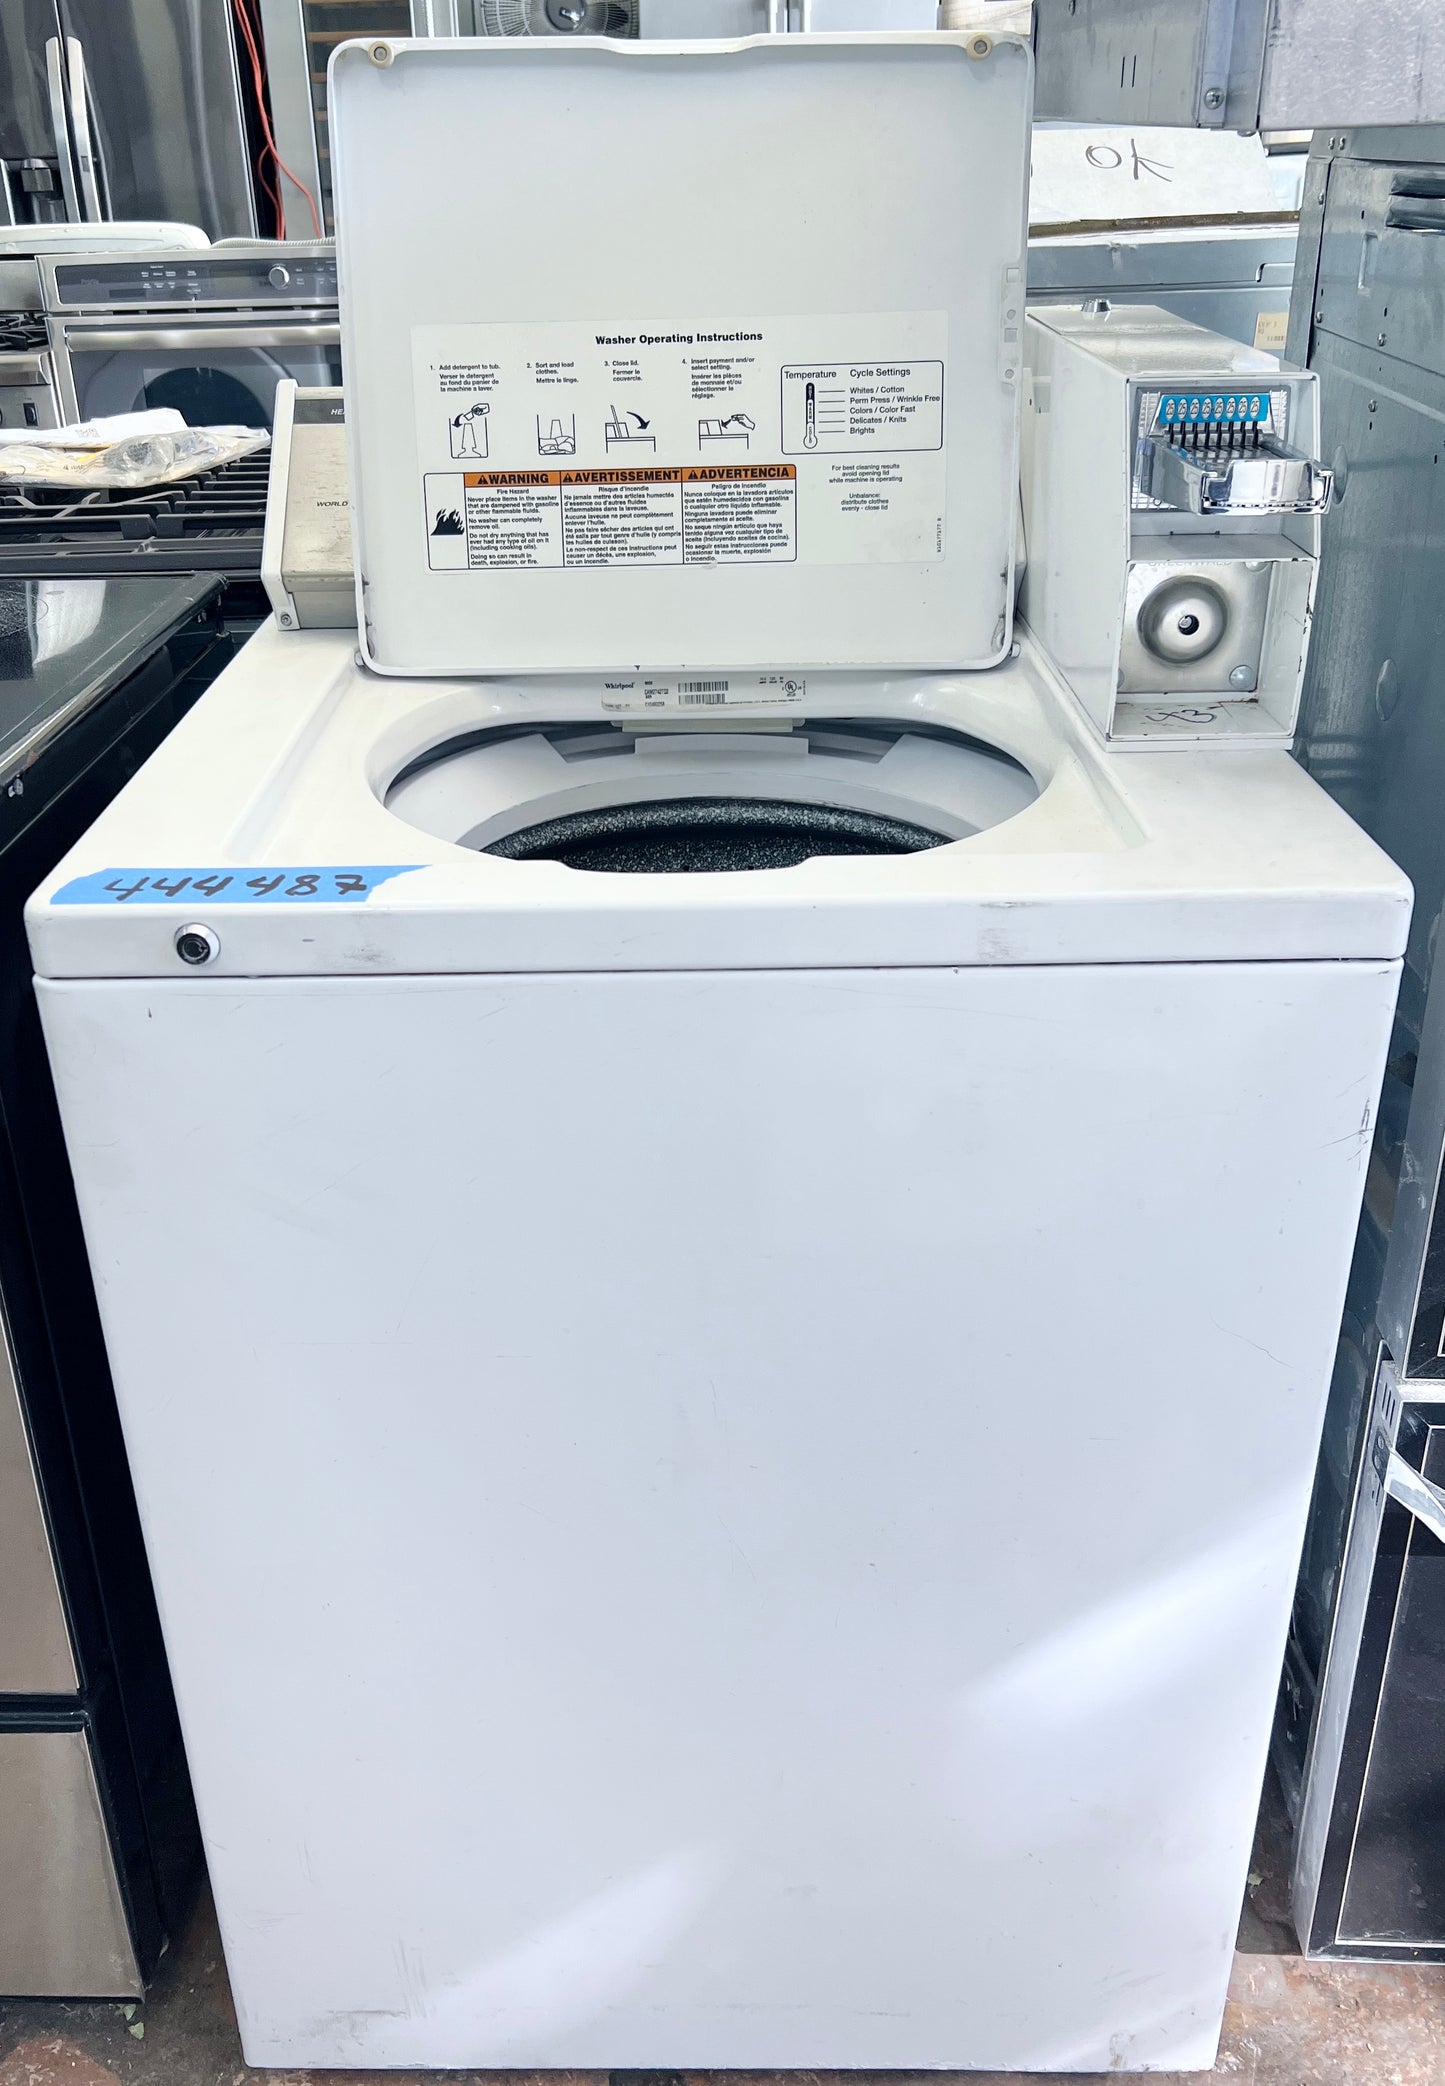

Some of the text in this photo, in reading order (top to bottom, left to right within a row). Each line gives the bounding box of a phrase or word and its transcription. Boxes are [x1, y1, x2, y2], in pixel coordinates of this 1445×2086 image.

[596, 332, 763, 345] Washer Operating Instructions
[785, 371, 837, 380] Temperature
[850, 368, 911, 378] Cycle Settings
[1166, 401, 1259, 415] 25 25 25 25 25 25 25 25
[850, 427, 875, 435] Brights
[489, 473, 549, 484] WARNING
[575, 470, 680, 482] AVERTISSEMENT
[700, 467, 789, 479] ADVERTENCIA
[604, 682, 635, 690] Whirlpool
[104, 876, 234, 901] 444
